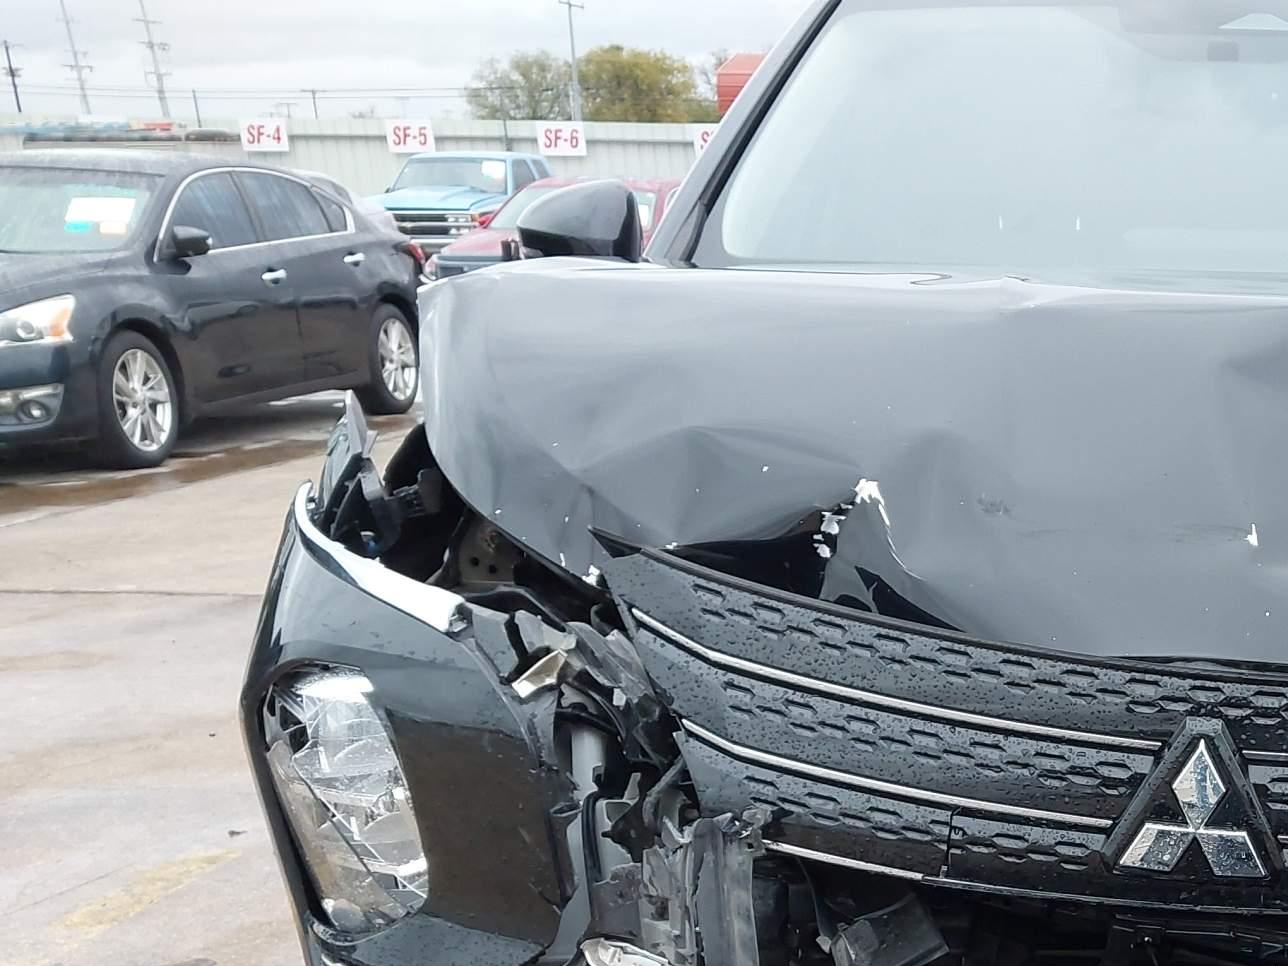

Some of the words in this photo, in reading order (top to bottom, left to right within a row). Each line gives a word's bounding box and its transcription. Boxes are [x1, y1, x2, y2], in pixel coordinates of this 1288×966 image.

[247, 124, 282, 145] SF-4
[392, 125, 428, 146] SF-5
[544, 128, 579, 149] SF-6
